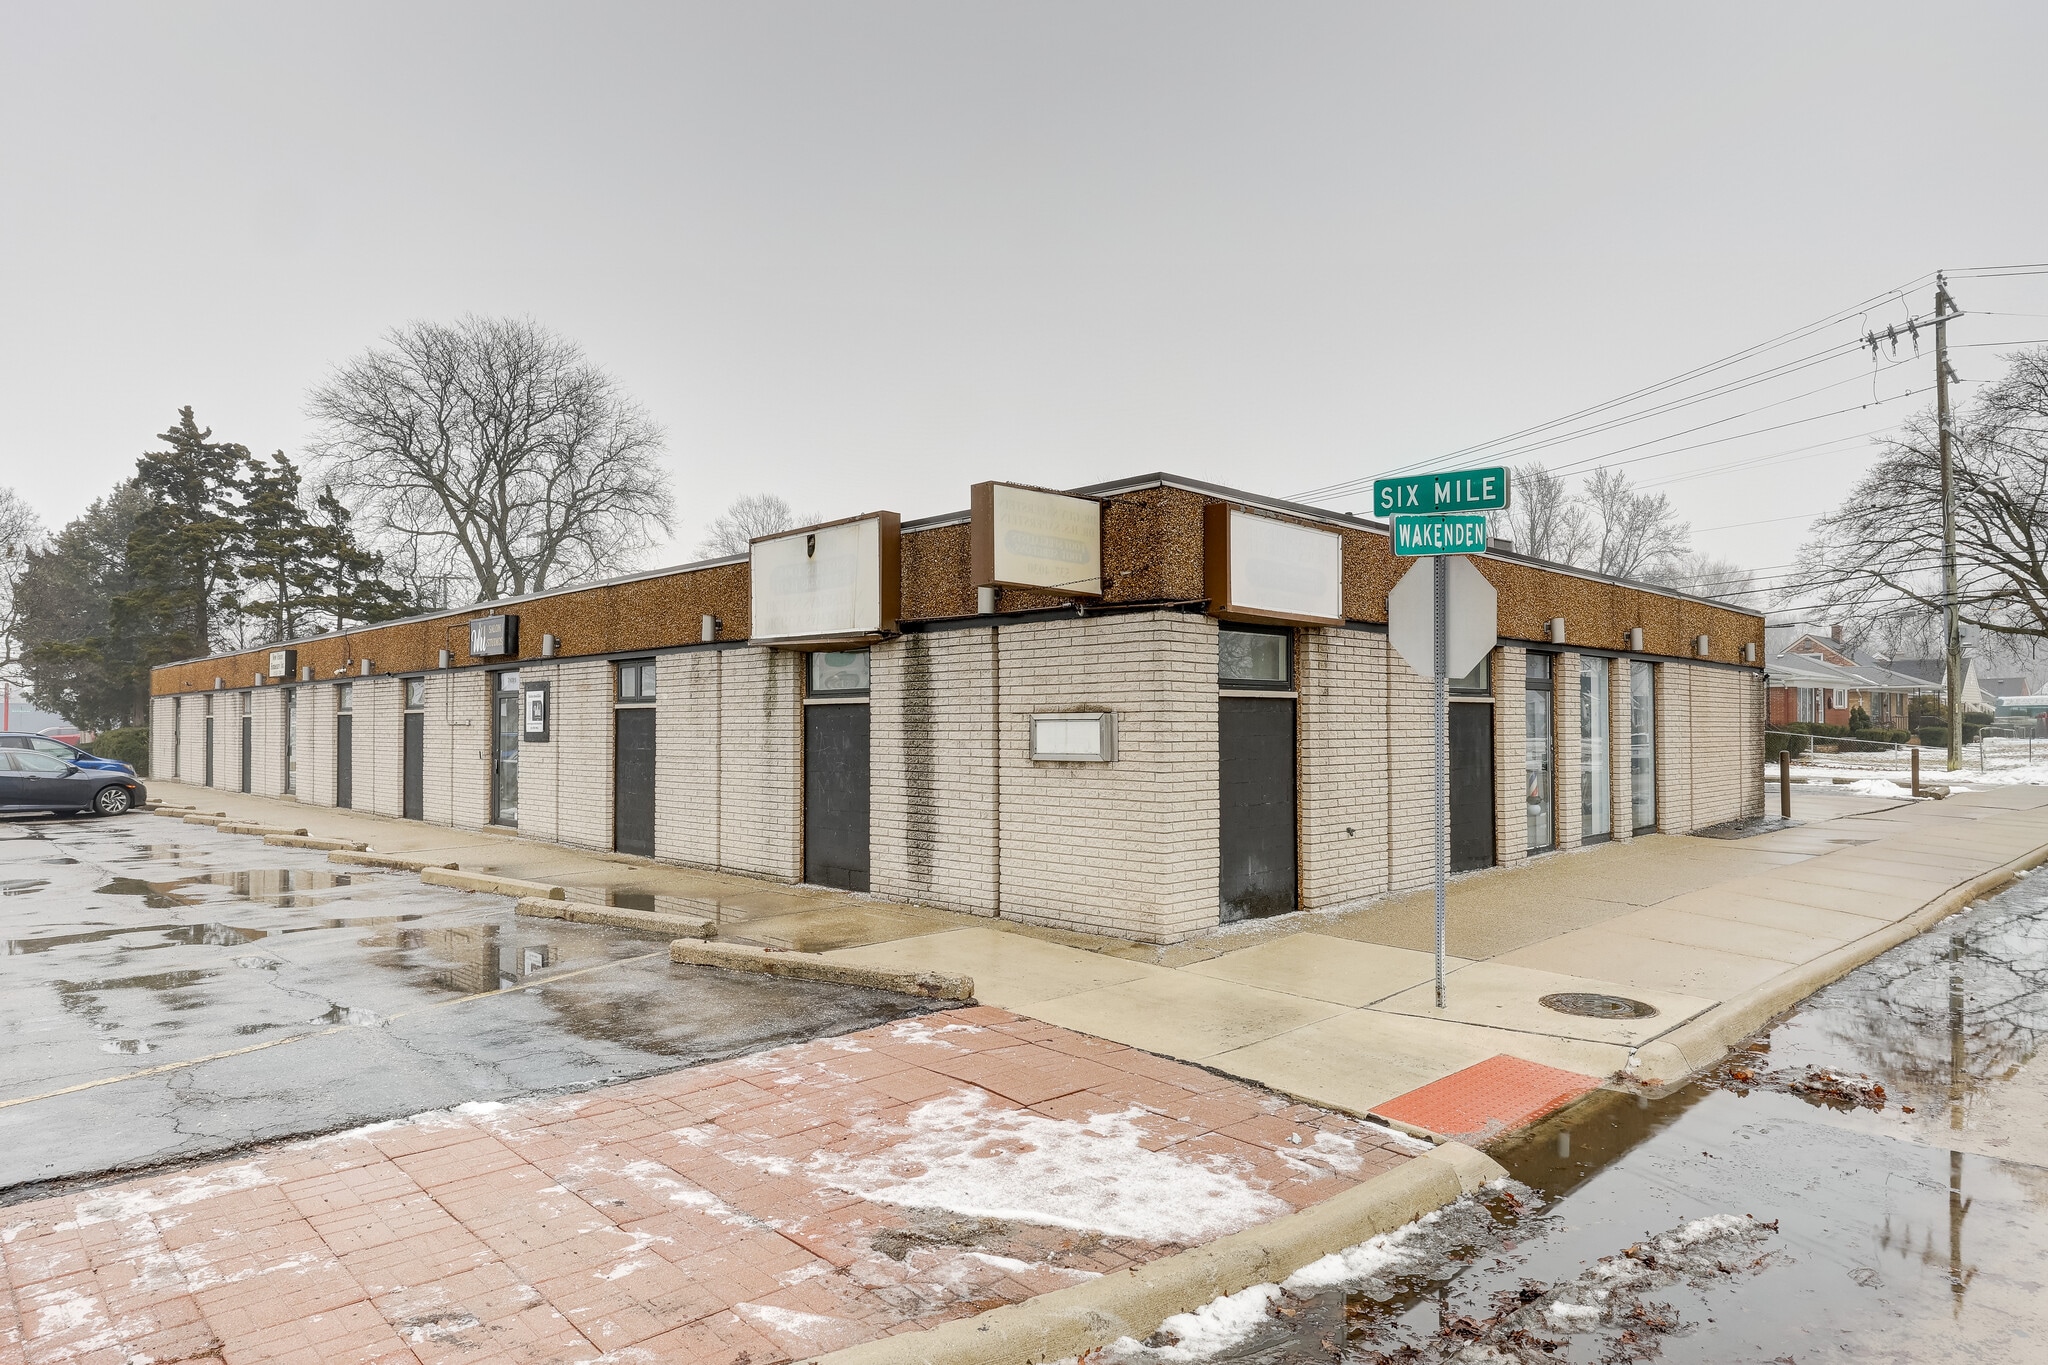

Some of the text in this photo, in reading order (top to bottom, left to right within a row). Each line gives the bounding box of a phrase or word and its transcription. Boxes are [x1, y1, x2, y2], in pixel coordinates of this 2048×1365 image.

[1380, 476, 1497, 509] SIX MILE
[1399, 523, 1484, 549] WAKENDEN
